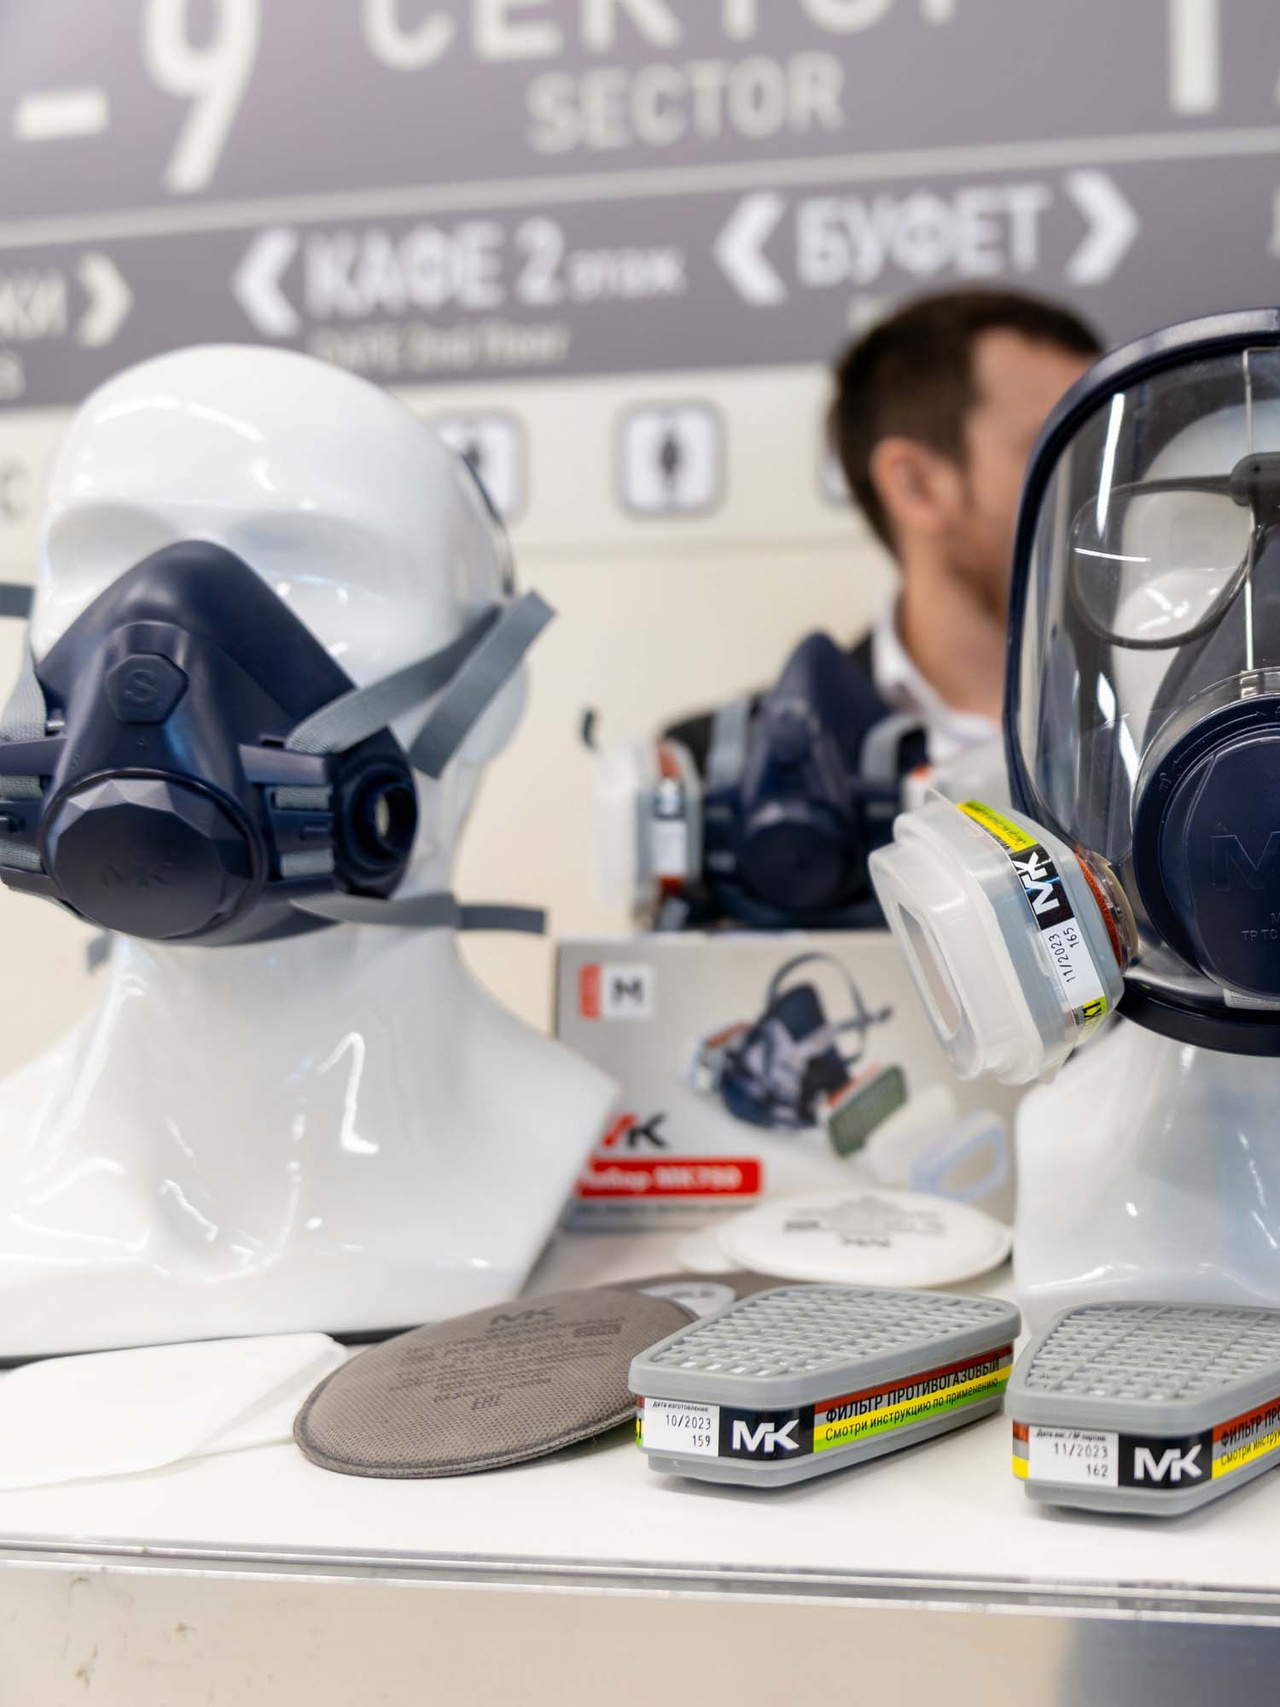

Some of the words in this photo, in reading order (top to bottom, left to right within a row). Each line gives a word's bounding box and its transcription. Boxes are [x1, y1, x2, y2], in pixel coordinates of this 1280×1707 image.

[524, 49, 845, 154] SECTOR
[797, 182, 1053, 288] БУФЕТ
[304, 219, 505, 319] КАФЕ
[515, 216, 565, 306] 2
[1011, 851, 1060, 915] MK
[1063, 927, 1080, 948] 165
[1049, 933, 1076, 982] 11/2023
[826, 1394, 883, 1424] ФИЛЬТР
[887, 1357, 1000, 1406] ПРОТИВОГАЗОВЫЙ
[666, 1414, 711, 1430] 10/2023
[826, 1422, 868, 1441] Смотри
[870, 1400, 931, 1425] инструкцию
[933, 1397, 945, 1407] по
[946, 1377, 999, 1404] применению
[692, 1434, 711, 1447] 159
[731, 1420, 800, 1453] MK
[1221, 1413, 1262, 1447] ФИЛЬТР
[1055, 1442, 1108, 1458] 11/2023
[1134, 1444, 1203, 1482] MK
[1221, 1442, 1251, 1466] Смотри
[1087, 1463, 1108, 1478] 162
